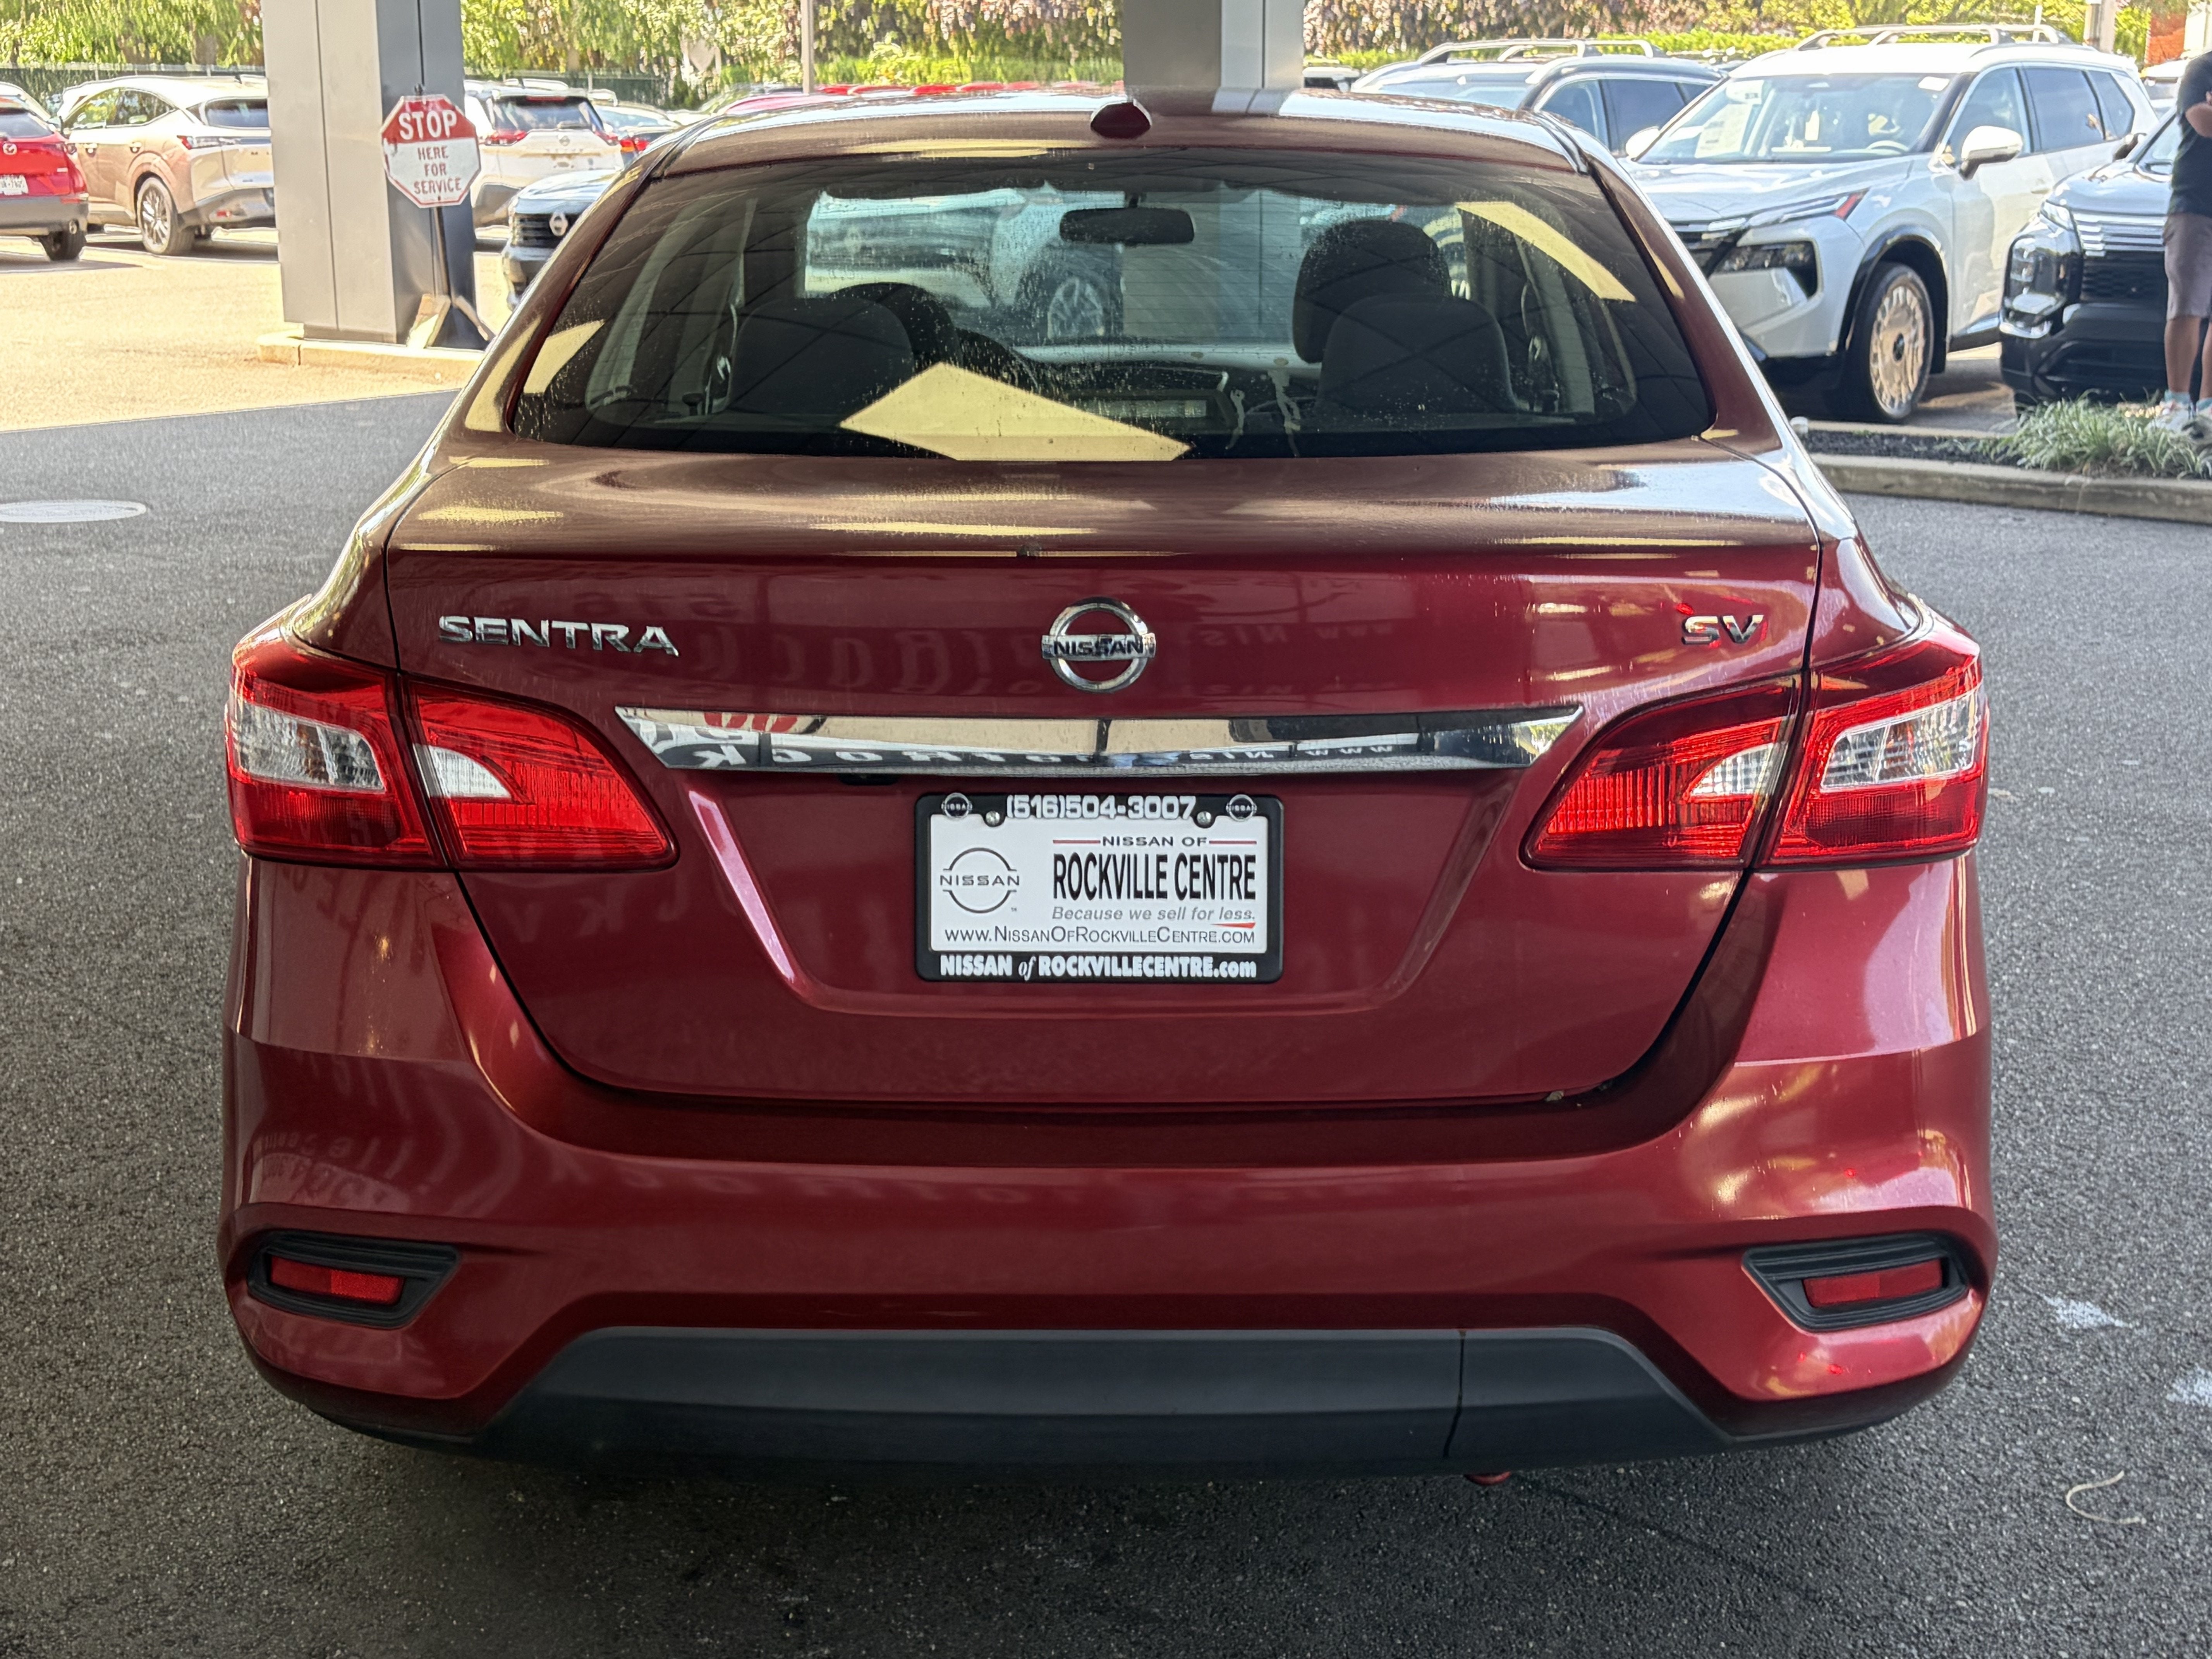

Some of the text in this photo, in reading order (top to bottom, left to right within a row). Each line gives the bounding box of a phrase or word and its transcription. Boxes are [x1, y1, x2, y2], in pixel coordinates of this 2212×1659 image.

[398, 110, 457, 140] STOP
[417, 145, 449, 160] HERE
[424, 162, 447, 177] FOR
[413, 177, 462, 194] SERVICE
[439, 616, 679, 657] SENTRA
[1681, 614, 1764, 645] SV
[1053, 639, 1143, 657] NISSAN
[1006, 795, 1197, 820] (516)504-3007
[1103, 836, 1207, 847] NISSAN OF
[940, 874, 1020, 887] NISSAN
[1053, 852, 1256, 901] ROCKVILLE CENTRE
[1052, 907, 1255, 921] Because we sell for less.
[940, 955, 1257, 981] NISSAN of ROCKVILLECENTRE.com
